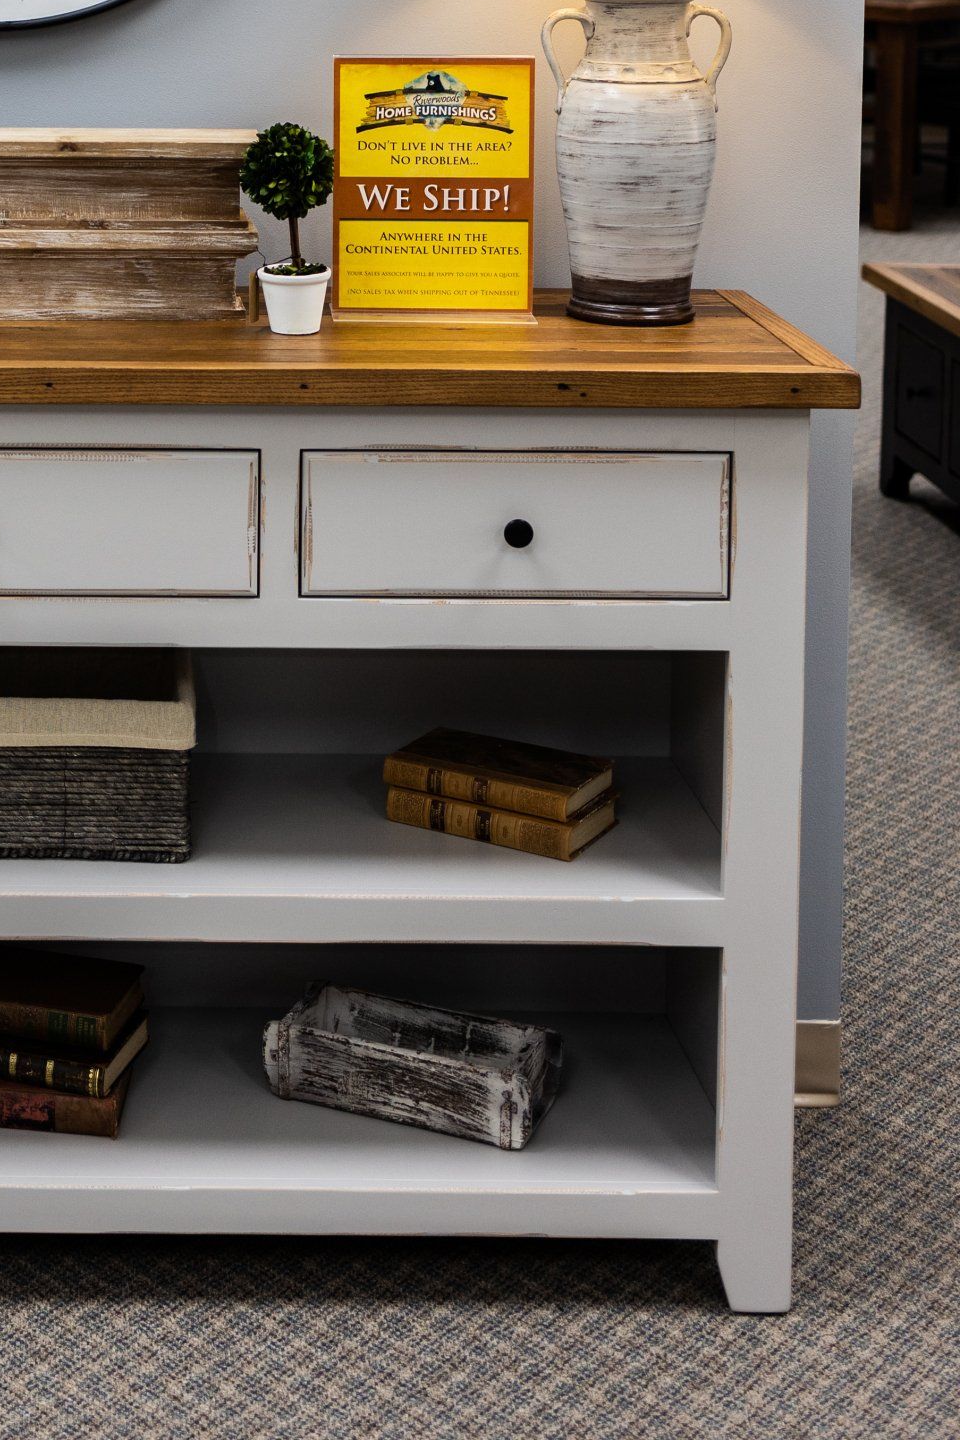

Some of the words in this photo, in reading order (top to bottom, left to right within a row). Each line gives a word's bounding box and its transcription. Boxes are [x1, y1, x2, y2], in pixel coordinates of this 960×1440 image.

[413, 92, 460, 106] Riverwoods
[376, 106, 412, 120] HOME
[416, 106, 497, 121] FURNISHINGS
[357, 140, 397, 151] DON'T
[401, 142, 426, 151] LIVE
[431, 142, 444, 151] IN
[448, 142, 472, 151] THE
[476, 141, 512, 151] AREA?
[390, 155, 410, 165] NO
[415, 156, 479, 165] PROBLEM...
[356, 183, 410, 210] WE
[423, 183, 510, 211] SHIP!
[380, 232, 443, 241] ANYWHERE
[448, 233, 461, 241] IN
[465, 233, 487, 242] THE
[345, 244, 428, 255] CONTINENTAL
[432, 245, 477, 255] UNITED
[481, 245, 522, 255] STATES.
